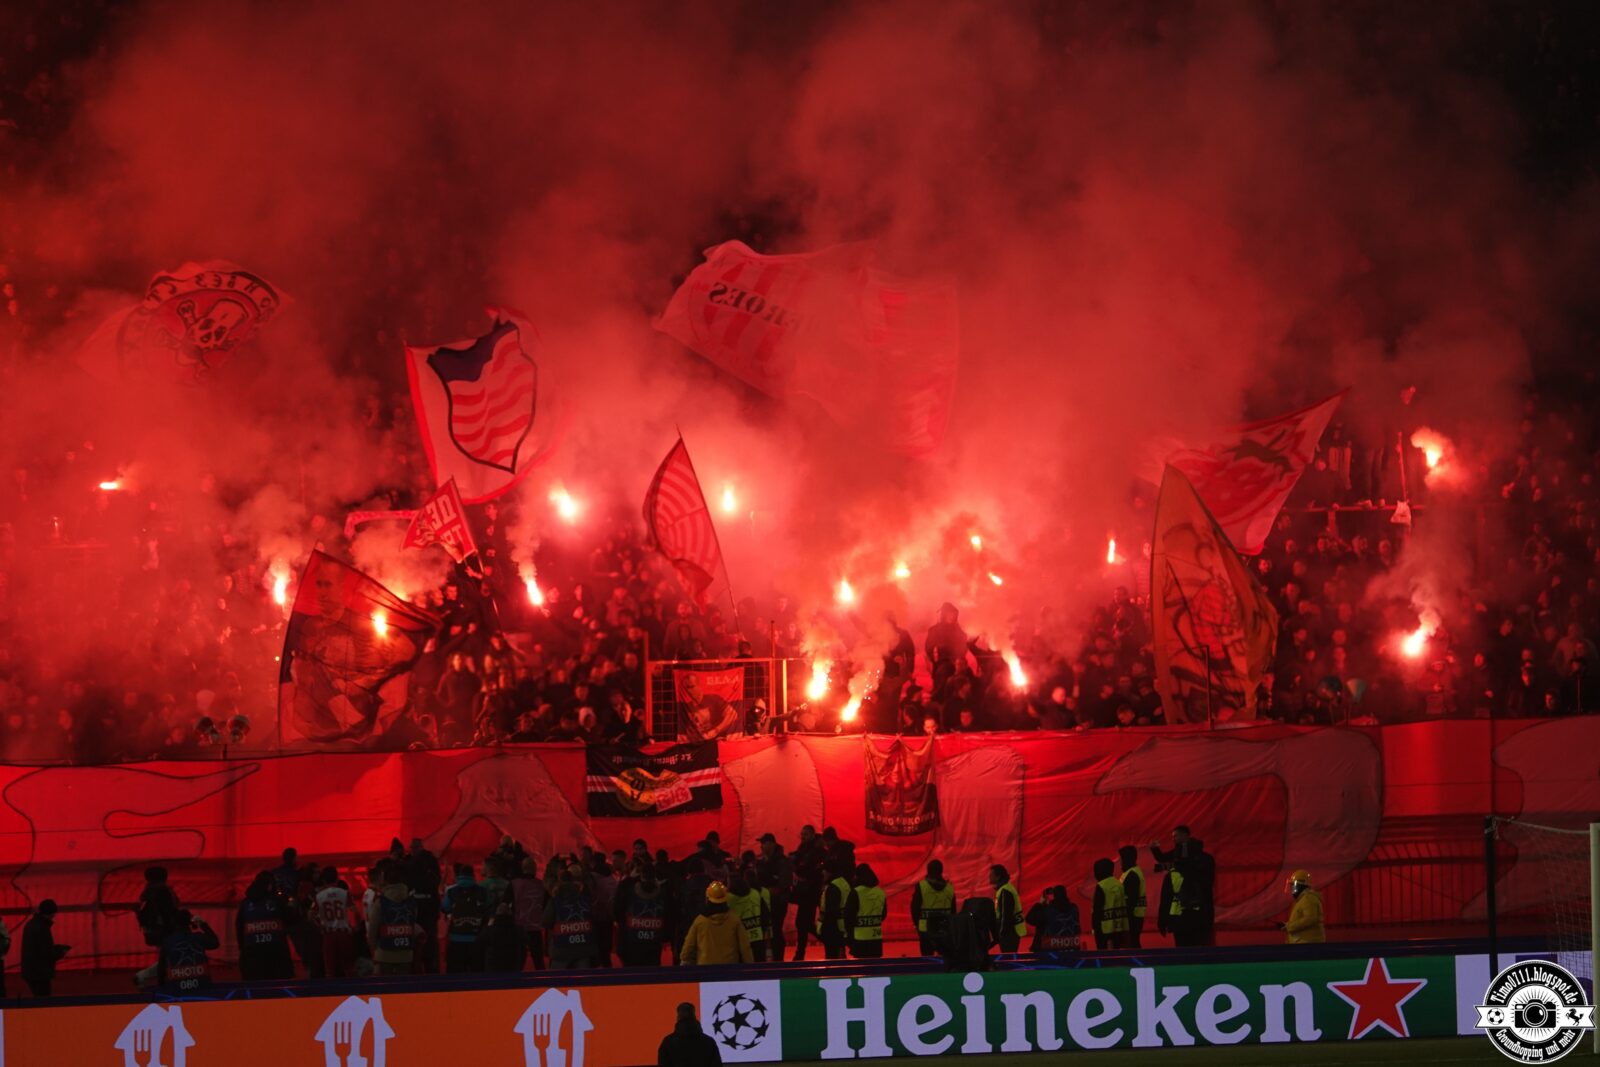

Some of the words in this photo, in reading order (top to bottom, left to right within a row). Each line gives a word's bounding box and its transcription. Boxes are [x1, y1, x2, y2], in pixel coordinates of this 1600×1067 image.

[322, 901, 344, 921] 66
[247, 920, 278, 933] PHOTO
[631, 918, 662, 928] PHOTO
[255, 933, 273, 943] 120
[1050, 936, 1080, 947] PHOTO
[171, 966, 205, 977] PHOTO
[819, 967, 1322, 1059] Heineken
